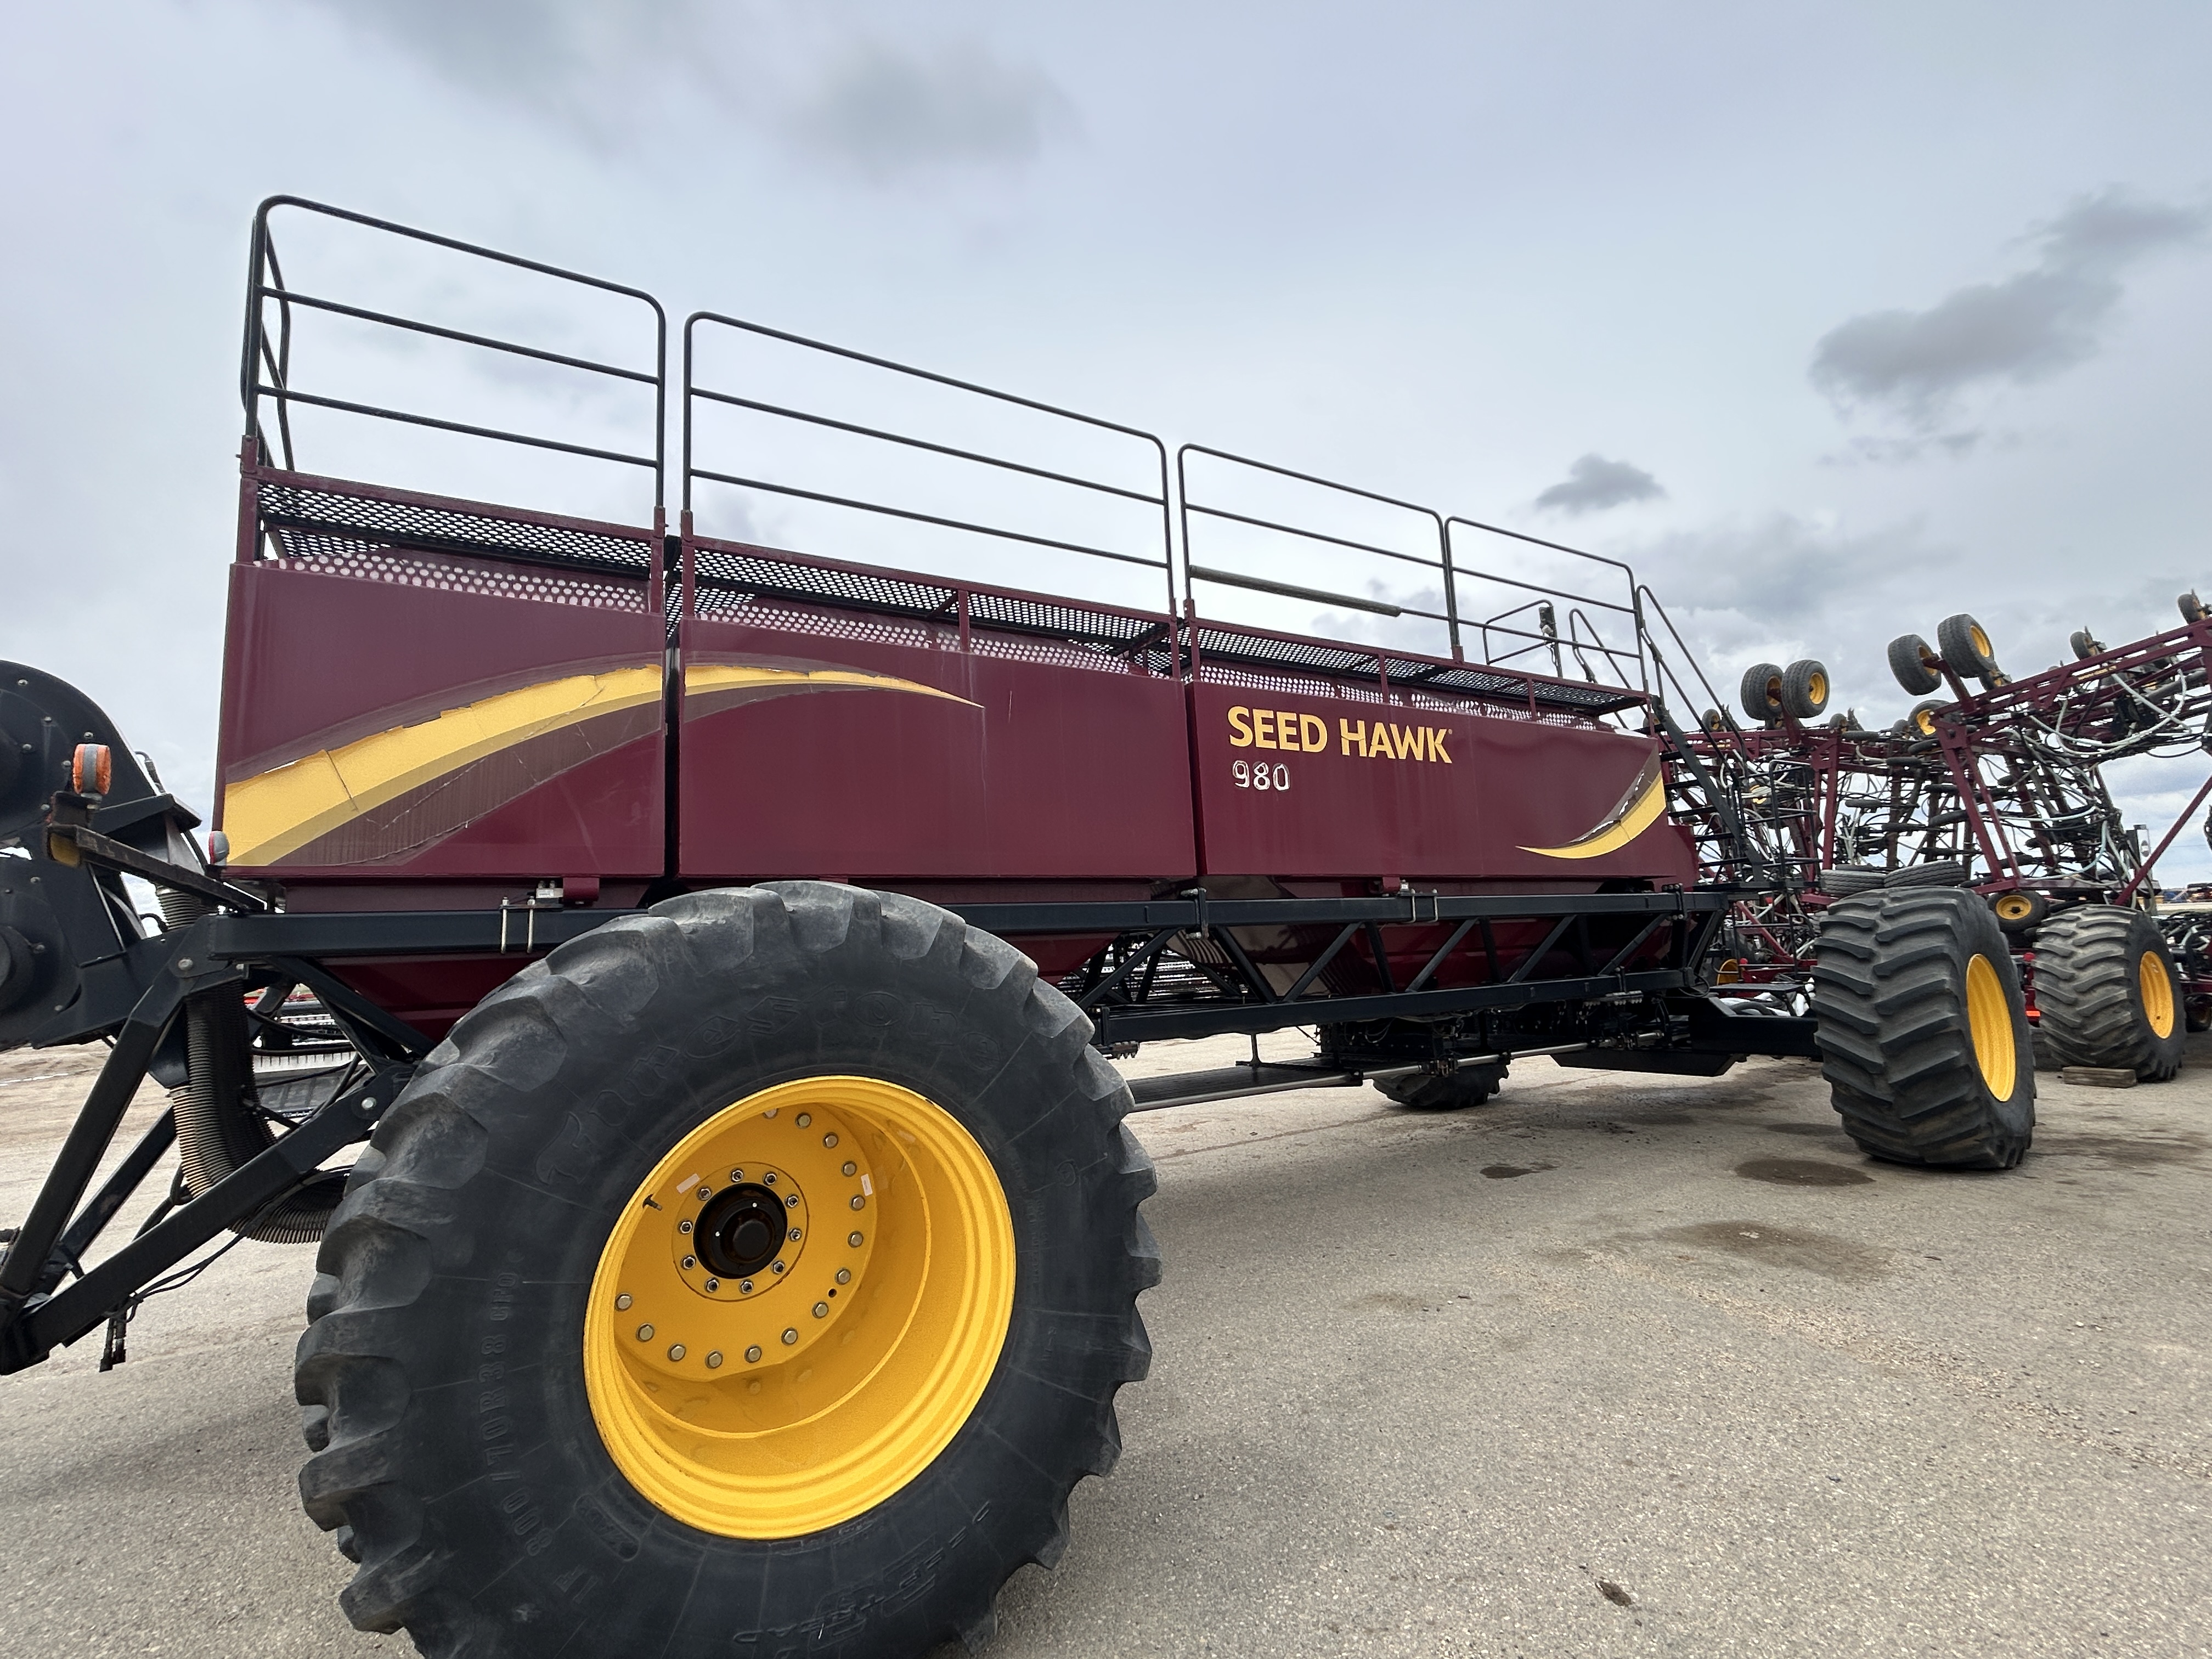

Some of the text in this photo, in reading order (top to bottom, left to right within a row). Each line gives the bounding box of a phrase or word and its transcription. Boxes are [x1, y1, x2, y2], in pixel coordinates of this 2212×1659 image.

[1227, 706, 1453, 763] SEED HAWK
[1232, 760, 1290, 791] 980
[535, 986, 1001, 1185] Firestone
[477, 1334, 553, 1556] 800/70R38
